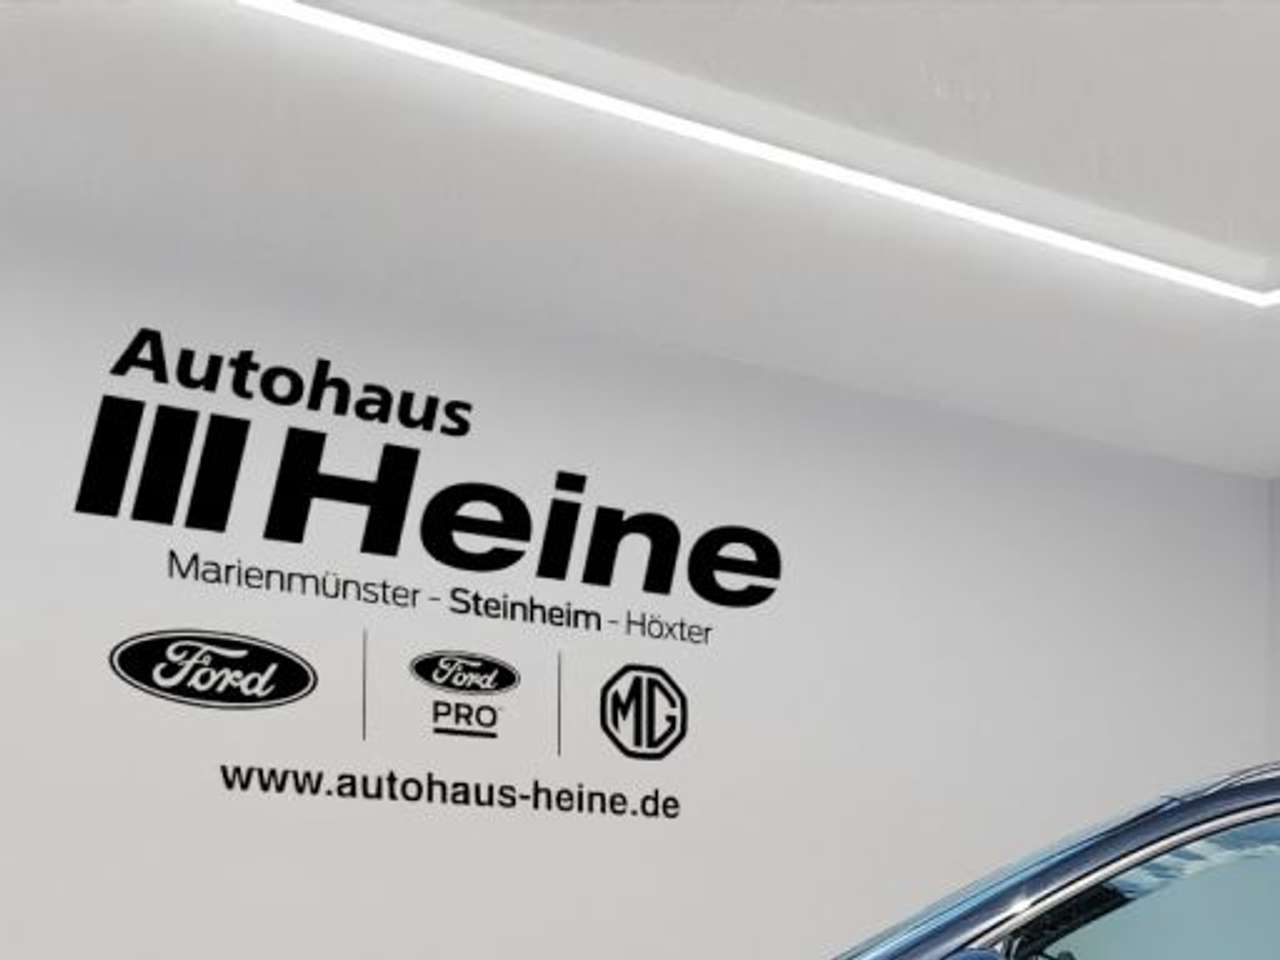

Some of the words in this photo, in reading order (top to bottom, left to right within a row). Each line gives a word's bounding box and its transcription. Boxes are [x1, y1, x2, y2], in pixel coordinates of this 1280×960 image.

[109, 327, 473, 437] Autohaus
[262, 426, 782, 609] Heine
[168, 549, 421, 608] Marienmünster
[449, 587, 603, 632] Steinheim
[625, 612, 713, 646] Höxter
[152, 640, 279, 698] Ford
[432, 657, 499, 689] Ford
[432, 700, 498, 728] PRO
[610, 675, 678, 749] MG
[220, 764, 681, 820] www.autohaus-heine.de
